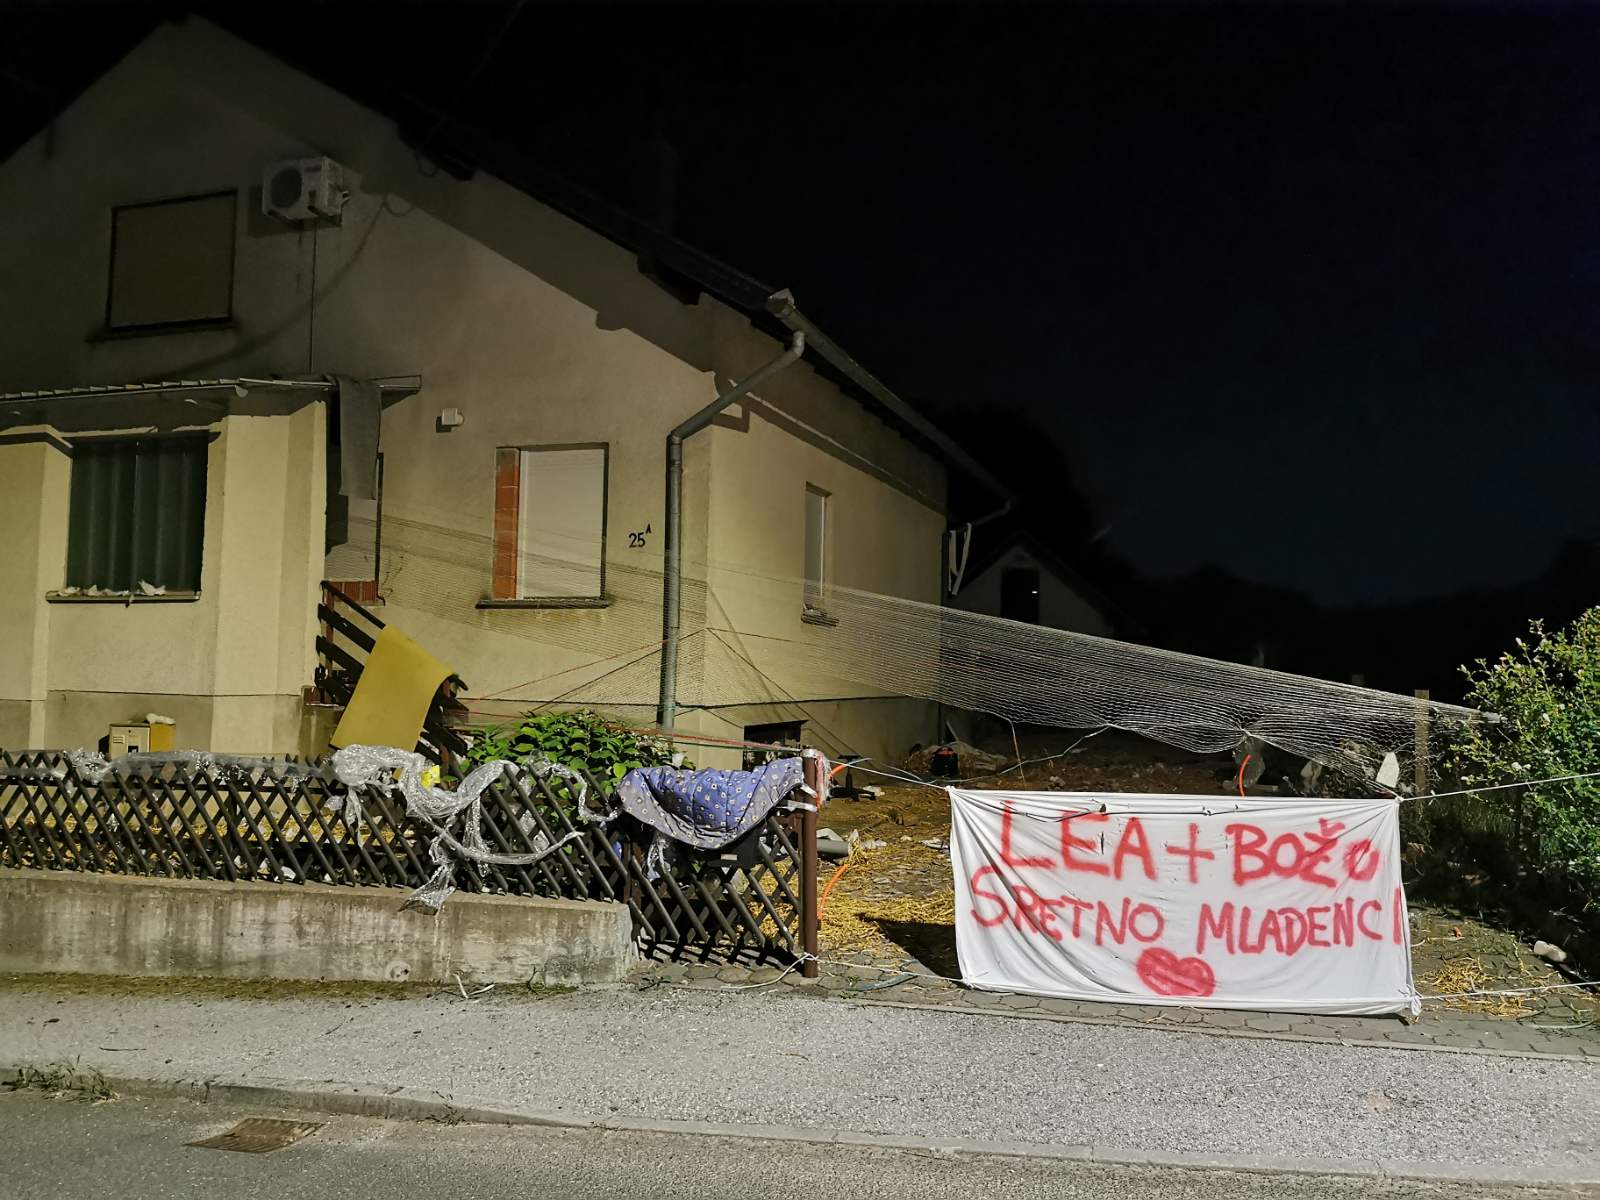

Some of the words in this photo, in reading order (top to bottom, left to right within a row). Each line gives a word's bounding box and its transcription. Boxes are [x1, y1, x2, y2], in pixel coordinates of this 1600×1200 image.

[1000, 800, 1157, 881] LEA
[970, 865, 1165, 946] SRETNO
[1196, 887, 1402, 956] MLADENCI
